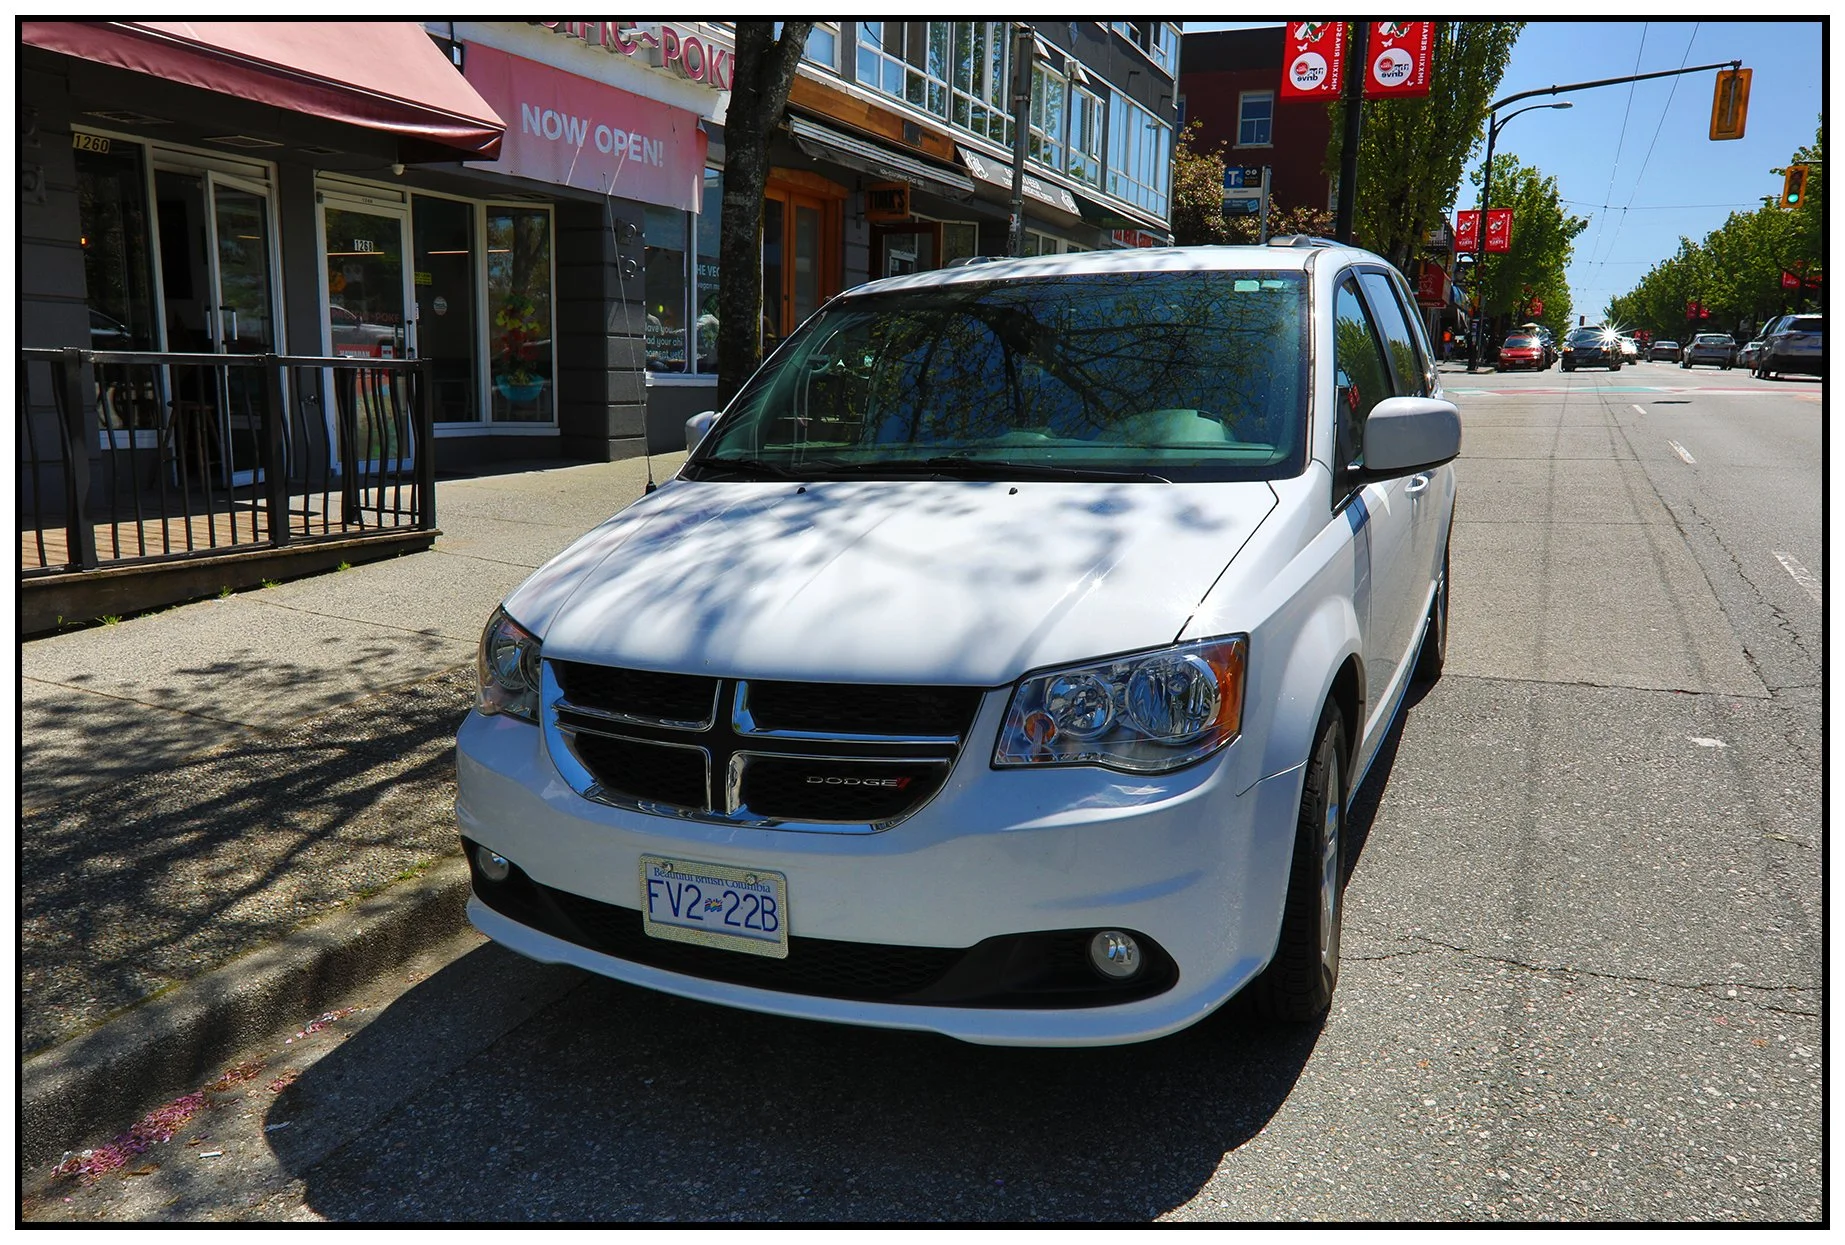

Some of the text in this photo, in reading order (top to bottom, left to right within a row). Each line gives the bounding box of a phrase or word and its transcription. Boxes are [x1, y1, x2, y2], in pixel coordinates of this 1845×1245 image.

[75, 134, 109, 152] 1260
[522, 103, 664, 168] NOW OPEN!
[806, 776, 899, 787] DODGE
[647, 878, 779, 932] FV2 22B
